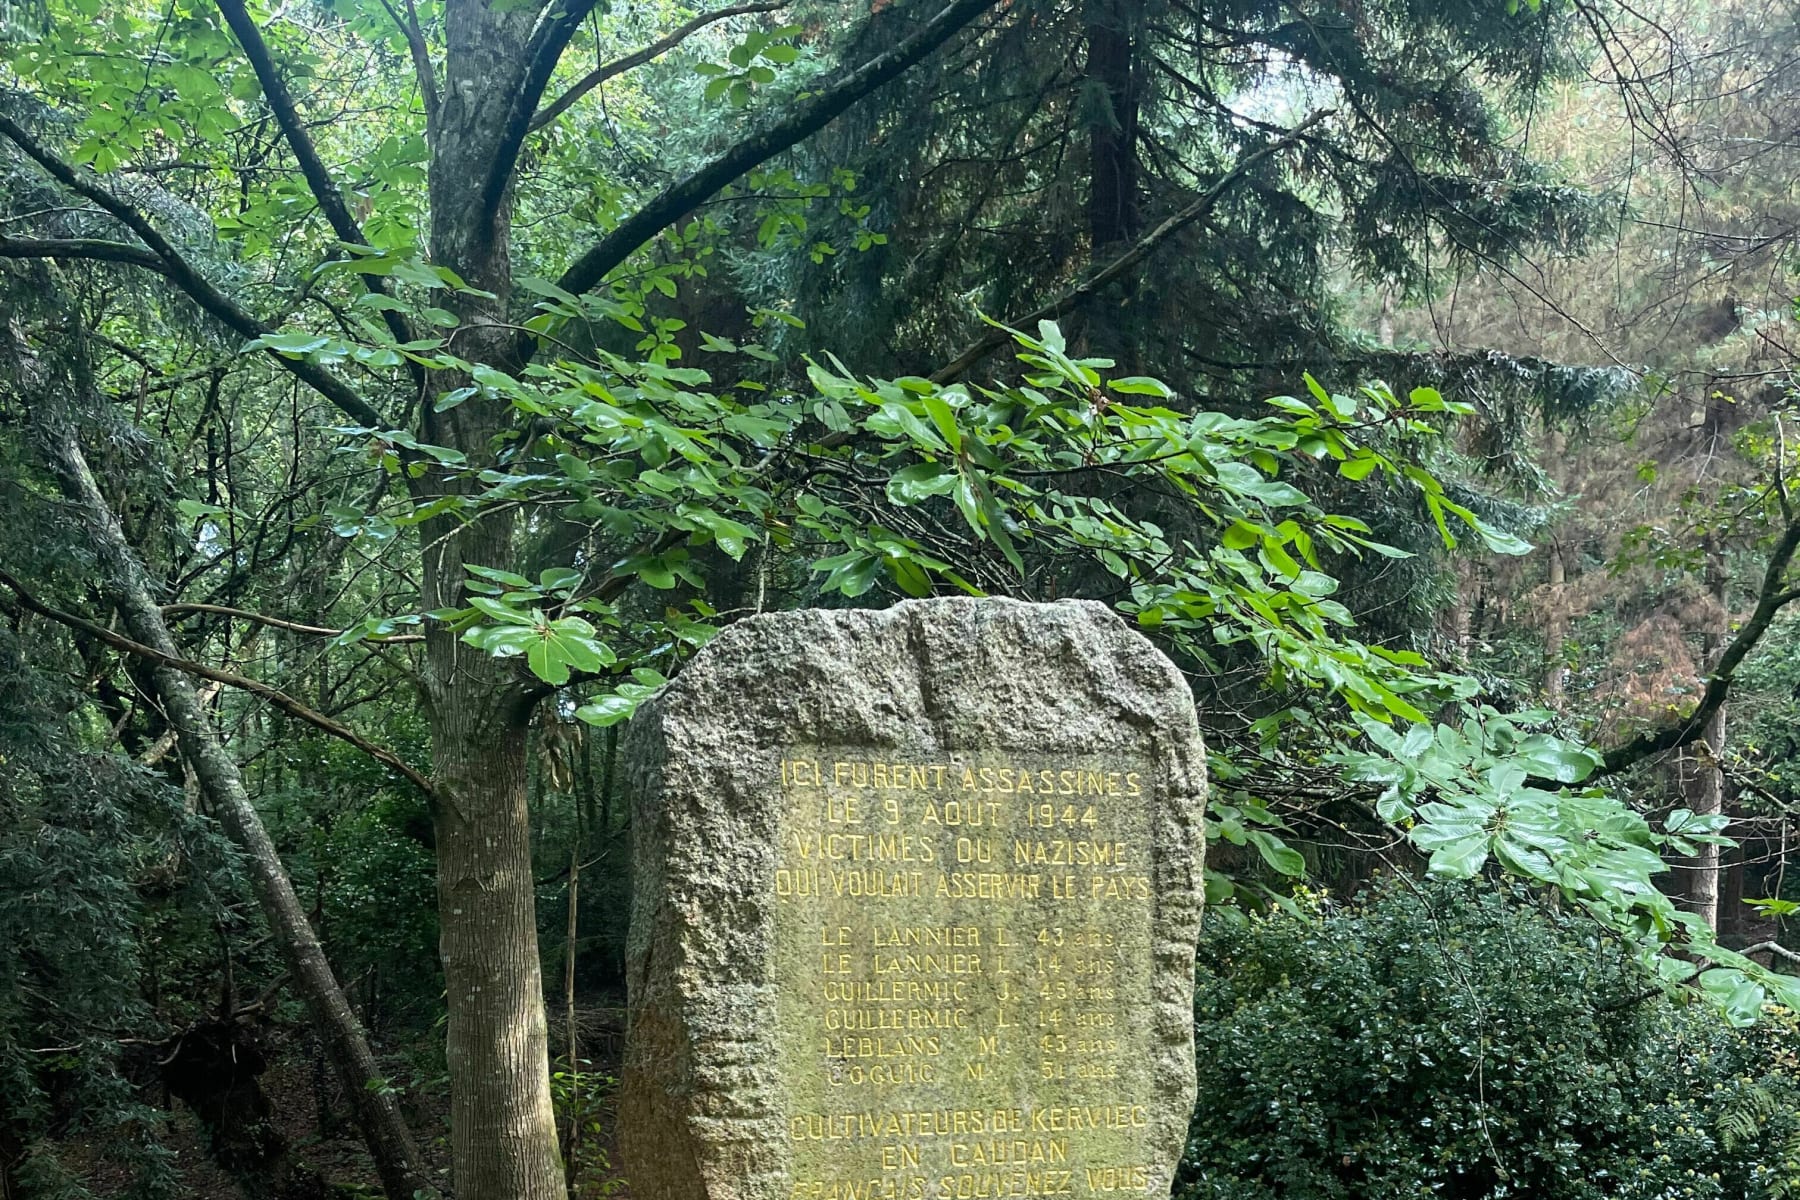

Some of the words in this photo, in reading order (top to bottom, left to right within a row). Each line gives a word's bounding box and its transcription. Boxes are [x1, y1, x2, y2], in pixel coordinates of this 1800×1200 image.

[782, 759, 822, 787] ICI
[834, 761, 948, 791] FURENT
[962, 767, 1142, 797] ASSASSINES
[828, 798, 861, 824] LE
[885, 799, 900, 825] 9
[922, 800, 1002, 827] AOUT
[1029, 804, 1099, 830] 1944
[793, 831, 935, 862] VICTIMES
[1015, 840, 1128, 867] NAZISME
[776, 869, 821, 897] QUI
[830, 870, 923, 898] VOULAIT
[935, 872, 1041, 899] ASSERVIR
[1053, 875, 1076, 900] LE
[1092, 876, 1151, 901] PAYS
[821, 926, 853, 946] LE
[873, 926, 981, 947] LANNIER
[1073, 932, 1115, 948] ans
[822, 954, 853, 974] LE
[874, 954, 983, 974] LANNIER
[1038, 954, 1063, 974] 14
[1074, 959, 1116, 974] ans
[823, 981, 968, 1001] GUILLERMIC
[1075, 987, 1116, 1001] ans
[825, 1008, 970, 1031] GUILLERMIC
[1039, 1009, 1063, 1027] 14
[1075, 1013, 1116, 1027] ans
[1076, 1039, 1118, 1053] ans
[791, 1110, 984, 1141] CULTIVATEURS
[993, 1110, 1023, 1132] DE
[1031, 1105, 1147, 1132] KERVIEC
[881, 1144, 920, 1171] EN
[951, 1137, 1069, 1168] CAUDAN
[1086, 1166, 1149, 1192] VOUS
